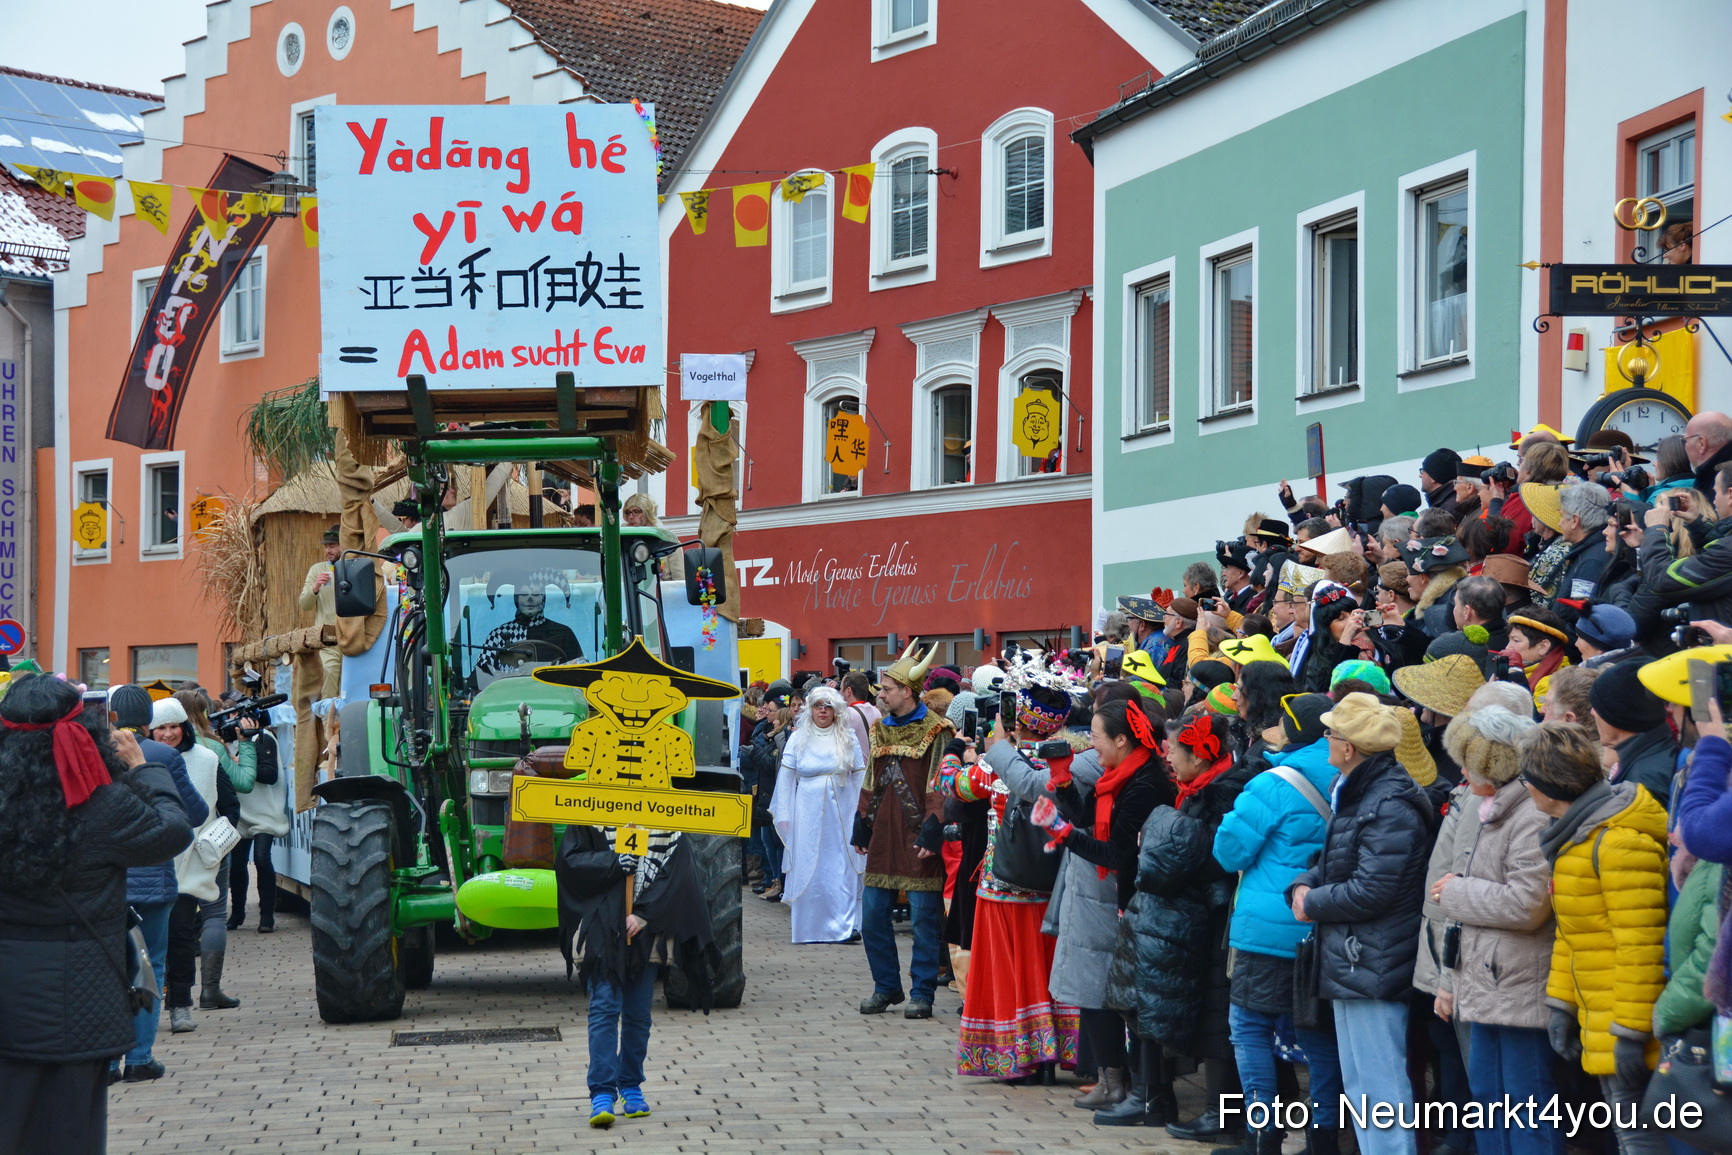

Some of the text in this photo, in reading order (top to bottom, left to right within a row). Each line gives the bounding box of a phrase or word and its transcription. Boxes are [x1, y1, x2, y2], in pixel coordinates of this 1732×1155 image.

[566, 112, 627, 173] hé
[412, 191, 584, 265] yī wá
[1571, 271, 1732, 294] RÖHLICH
[1607, 295, 1650, 310] Juwelier
[397, 325, 504, 378] Adam
[511, 328, 588, 367] sucht
[593, 326, 647, 365] Eva
[689, 371, 736, 384] Vogelthal
[1622, 410, 1631, 423] 11
[1637, 405, 1650, 419] 12
[0, 362, 16, 620] UHREN SCHMUCK
[783, 548, 822, 587] Mode
[823, 558, 863, 593] Genuss
[868, 541, 918, 578] Erlebnis
[803, 541, 1034, 627] Mode Genuss Erlebnis
[555, 794, 715, 817] Landjugend Vogelthal
[624, 832, 638, 851] 4
